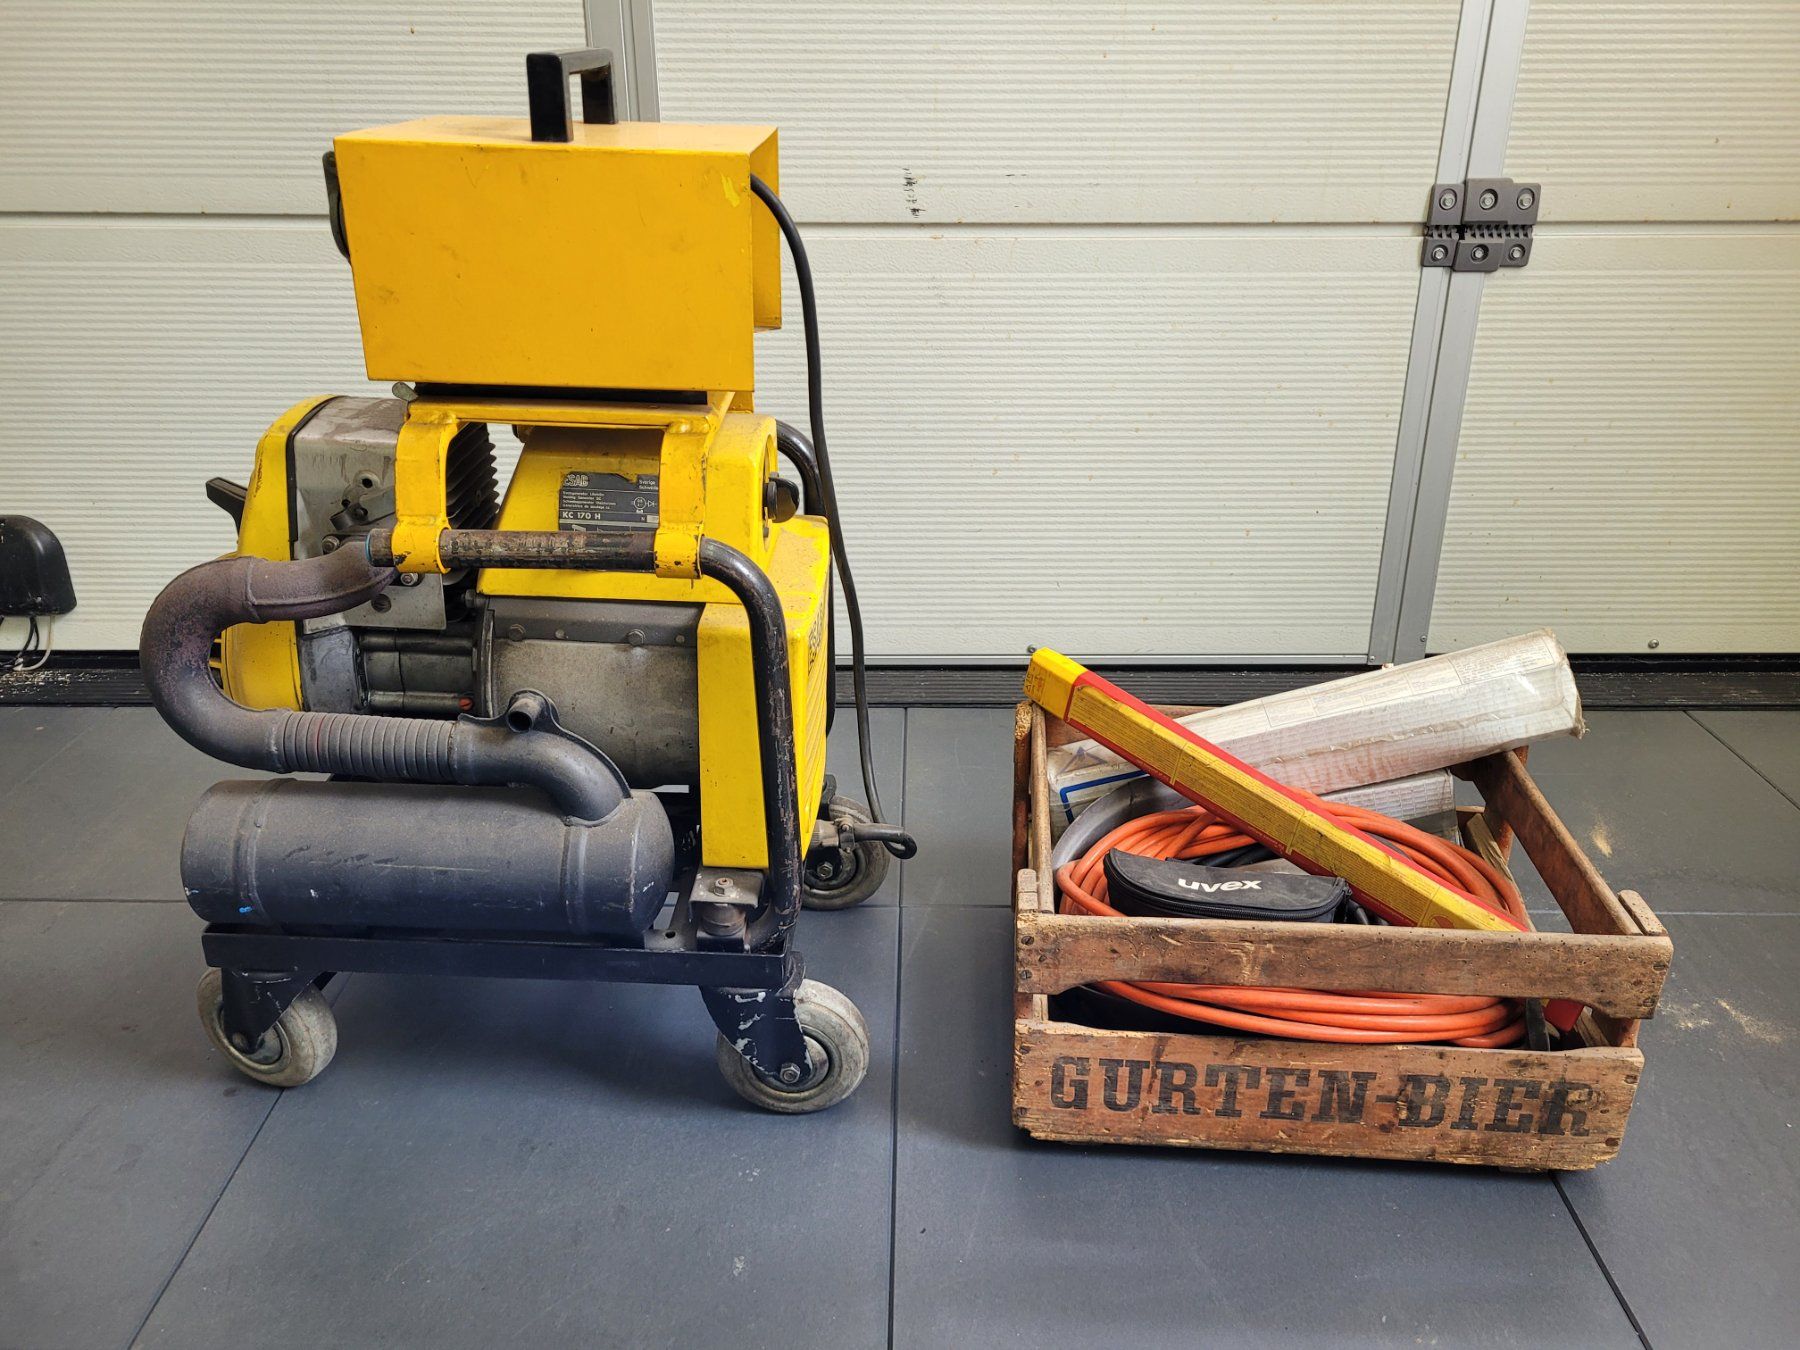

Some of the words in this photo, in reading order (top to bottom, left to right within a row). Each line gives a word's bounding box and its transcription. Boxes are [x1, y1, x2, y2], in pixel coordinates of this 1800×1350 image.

[562, 511, 574, 519] KC
[577, 512, 592, 520] 170
[1178, 878, 1262, 893] uvex
[1050, 1056, 1595, 1138] GURTEN-BIER
